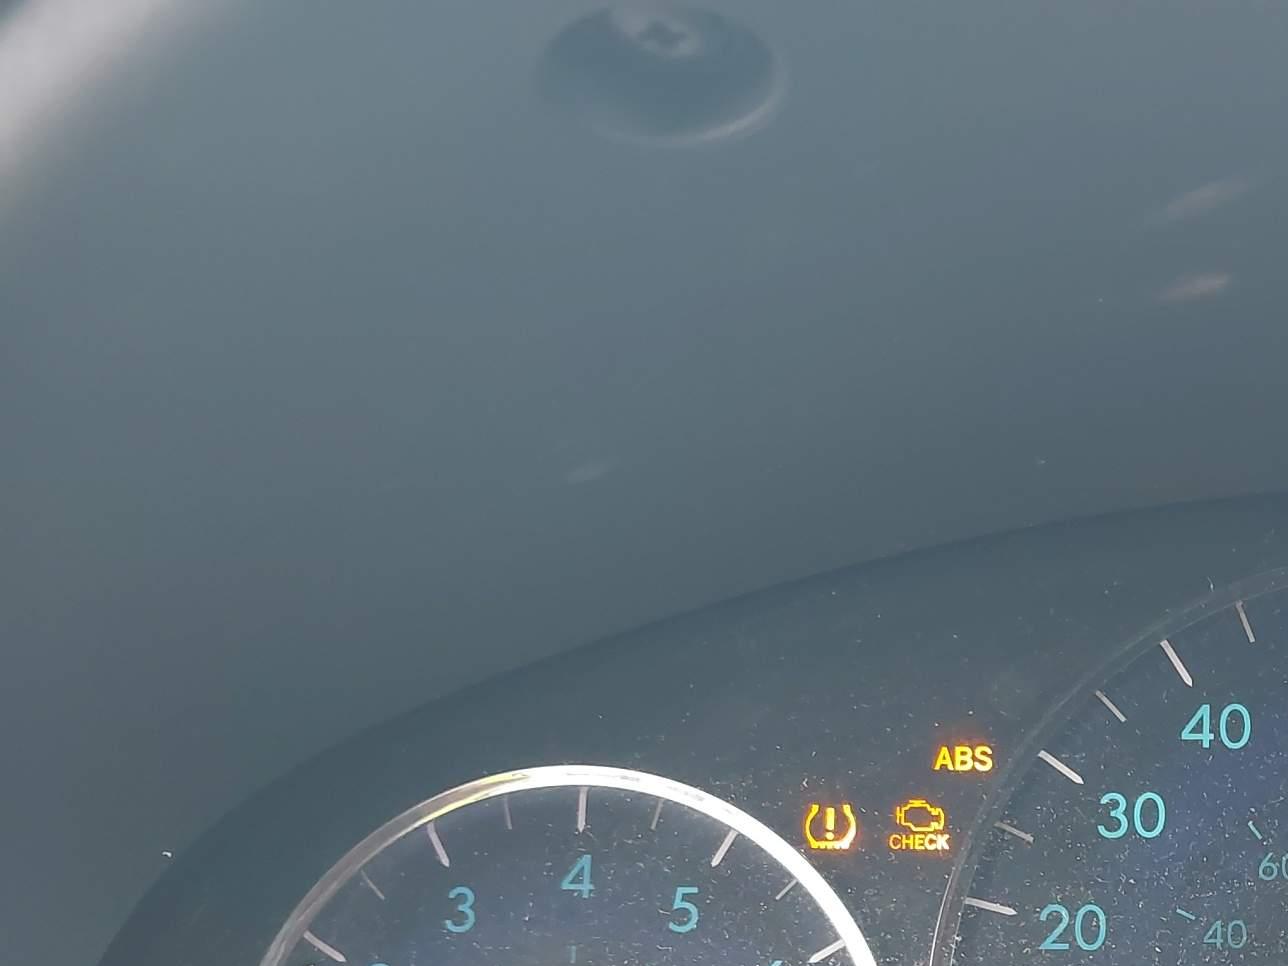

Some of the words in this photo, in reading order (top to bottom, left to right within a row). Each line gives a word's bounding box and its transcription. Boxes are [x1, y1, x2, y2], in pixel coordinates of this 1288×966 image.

[1180, 703, 1253, 750] 40
[933, 745, 993, 772] ABS
[1096, 791, 1168, 840] 30
[888, 833, 950, 851] CHECK
[559, 854, 594, 899] 4
[446, 885, 476, 933] 3
[669, 885, 701, 934] 5
[1039, 903, 1107, 952] 20
[1202, 918, 1248, 951] 40
